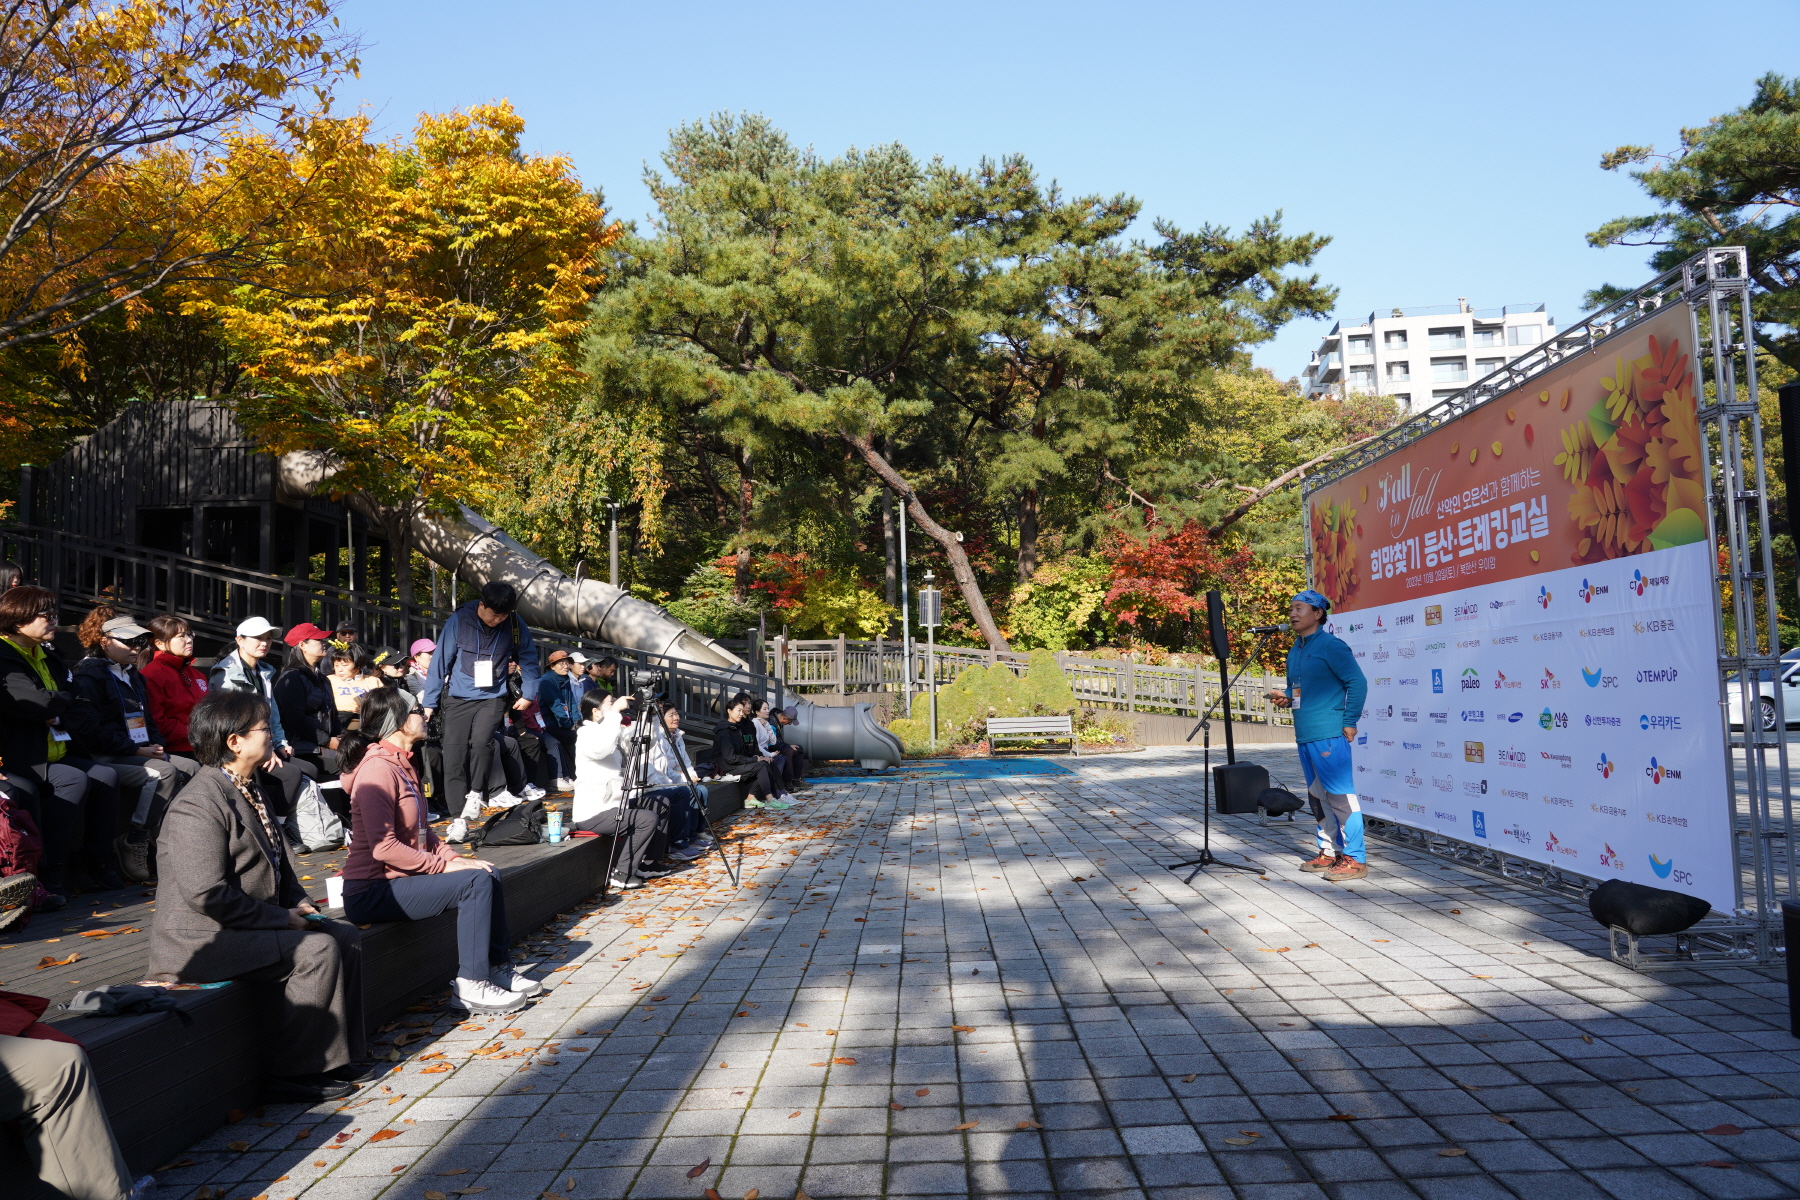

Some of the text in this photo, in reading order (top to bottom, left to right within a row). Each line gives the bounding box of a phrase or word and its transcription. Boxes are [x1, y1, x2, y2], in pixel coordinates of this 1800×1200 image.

[1377, 462, 1411, 514] Fall
[1437, 467, 1541, 520] 산악인 오은선과 함께하는
[1390, 467, 1443, 539] in fall
[1370, 536, 1421, 580] 희망찾기
[1460, 561, 1477, 575] 북한산
[1579, 585, 1609, 598] CJ ENM
[1630, 580, 1638, 591] CJ
[1537, 595, 1544, 604] CJ
[1646, 619, 1675, 633] KB증권
[1461, 676, 1480, 692] paleo
[1494, 680, 1502, 689] SK
[1540, 679, 1549, 689] SK
[1601, 676, 1619, 688] SPC
[1554, 712, 1568, 728] 신송
[1592, 716, 1622, 726] 신한투자증권
[1650, 715, 1682, 730] 우리카드
[1596, 763, 1604, 772] CJ
[1645, 767, 1682, 779] CJ ENM
[1545, 841, 1554, 852] SK
[1600, 854, 1610, 867] SK
[1673, 869, 1693, 886] SPC
